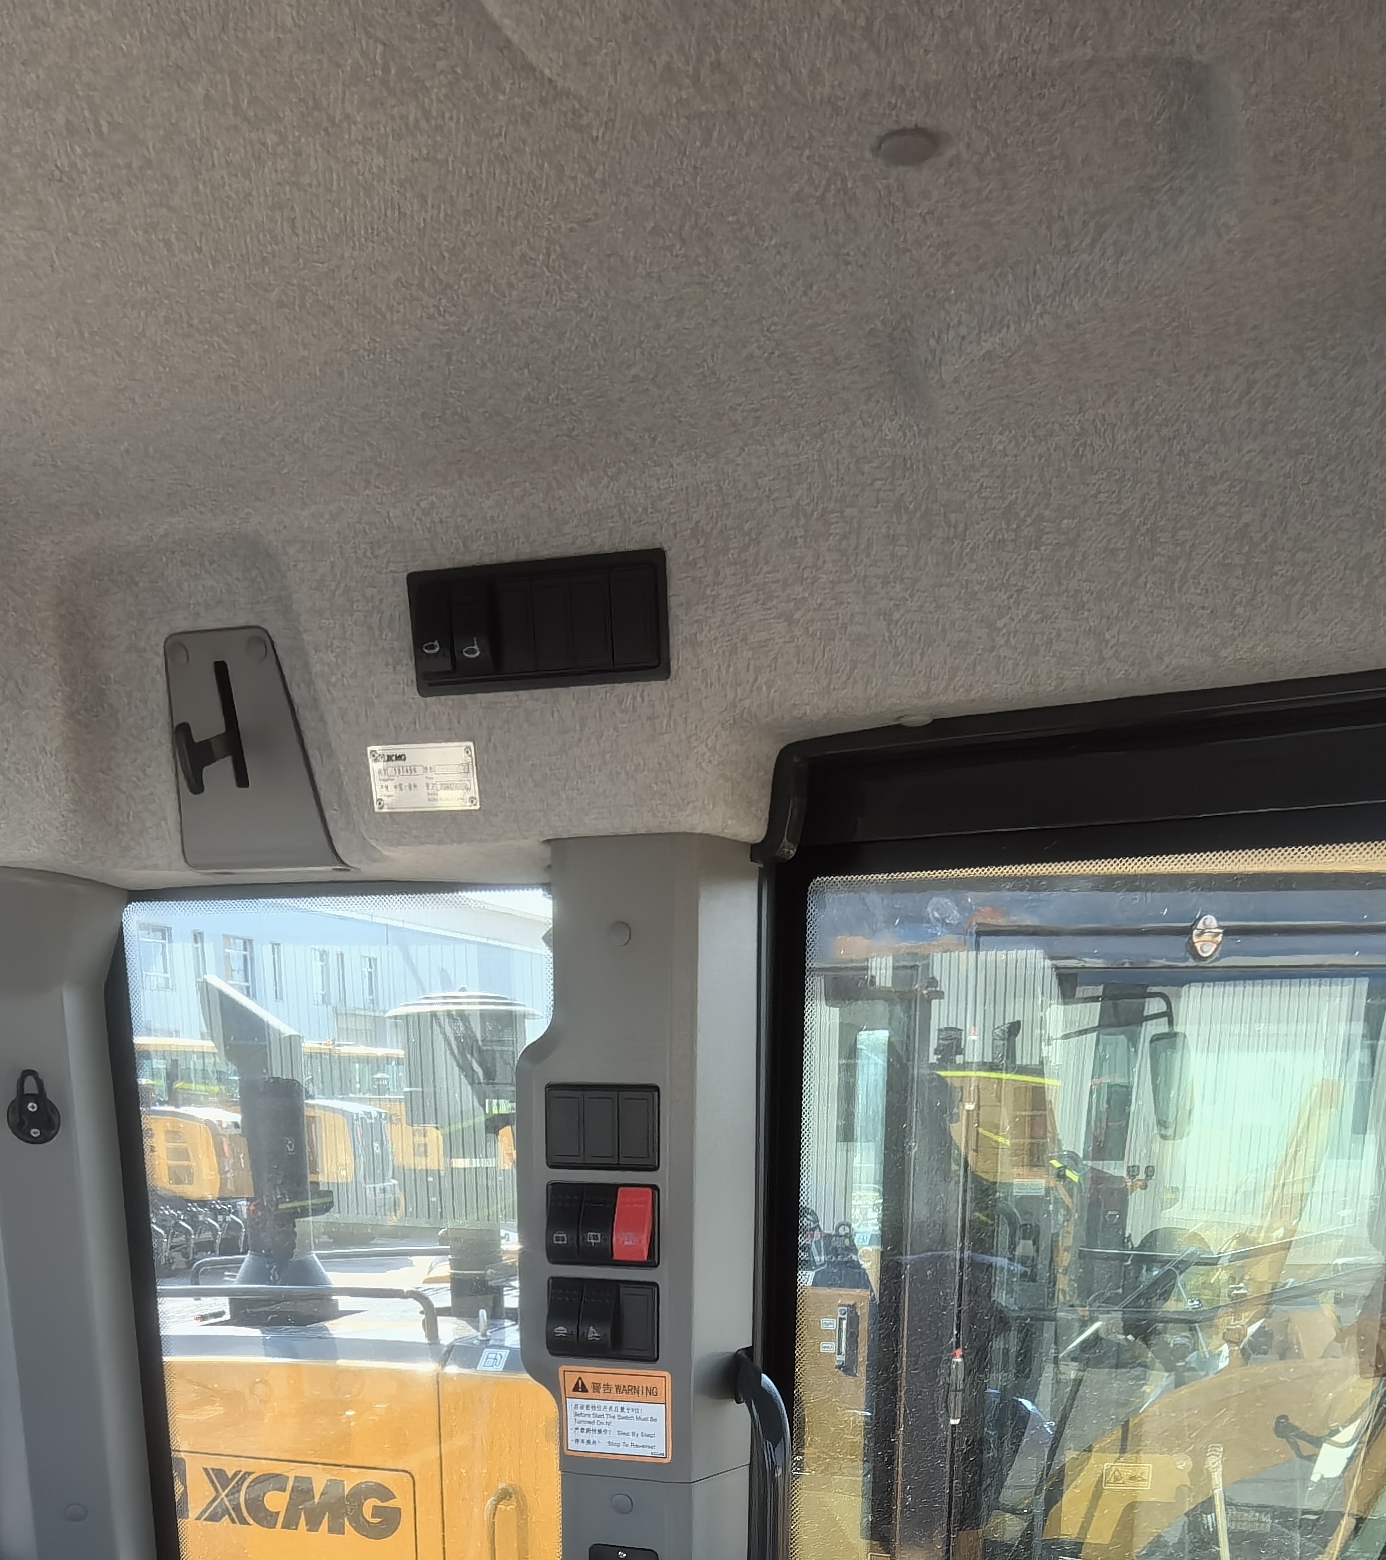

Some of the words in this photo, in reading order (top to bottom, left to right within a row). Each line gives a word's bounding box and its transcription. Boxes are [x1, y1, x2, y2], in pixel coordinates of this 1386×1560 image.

[592, 1382, 612, 1394] 警告
[615, 1384, 658, 1397] WARNING
[195, 1467, 402, 1540] XCMG
